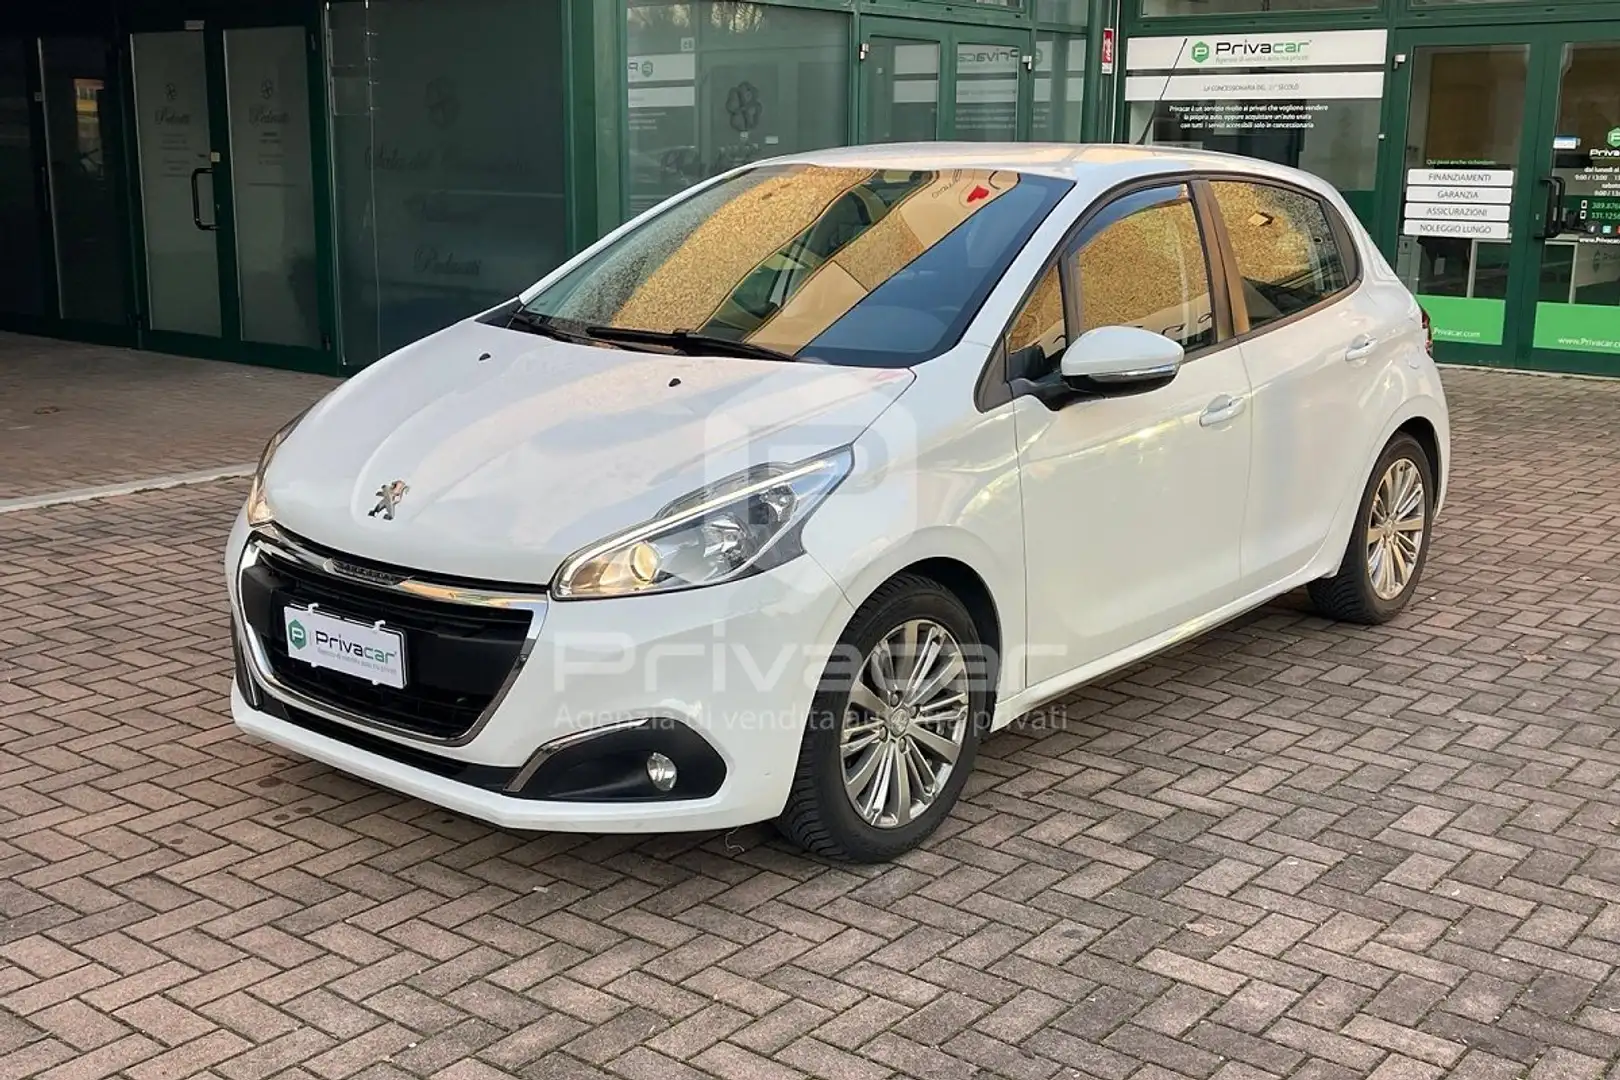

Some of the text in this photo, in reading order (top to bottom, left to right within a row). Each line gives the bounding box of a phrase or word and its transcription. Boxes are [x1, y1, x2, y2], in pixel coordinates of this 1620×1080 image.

[1215, 39, 1309, 55] Privacar
[1428, 173, 1492, 182] FINANZIAMENTI
[1437, 190, 1480, 199] GARANZIA
[1426, 207, 1488, 217] ASSICURAZIONI
[1419, 224, 1492, 234] NOLEGGIO LUNGO
[315, 629, 396, 664] Privacar
